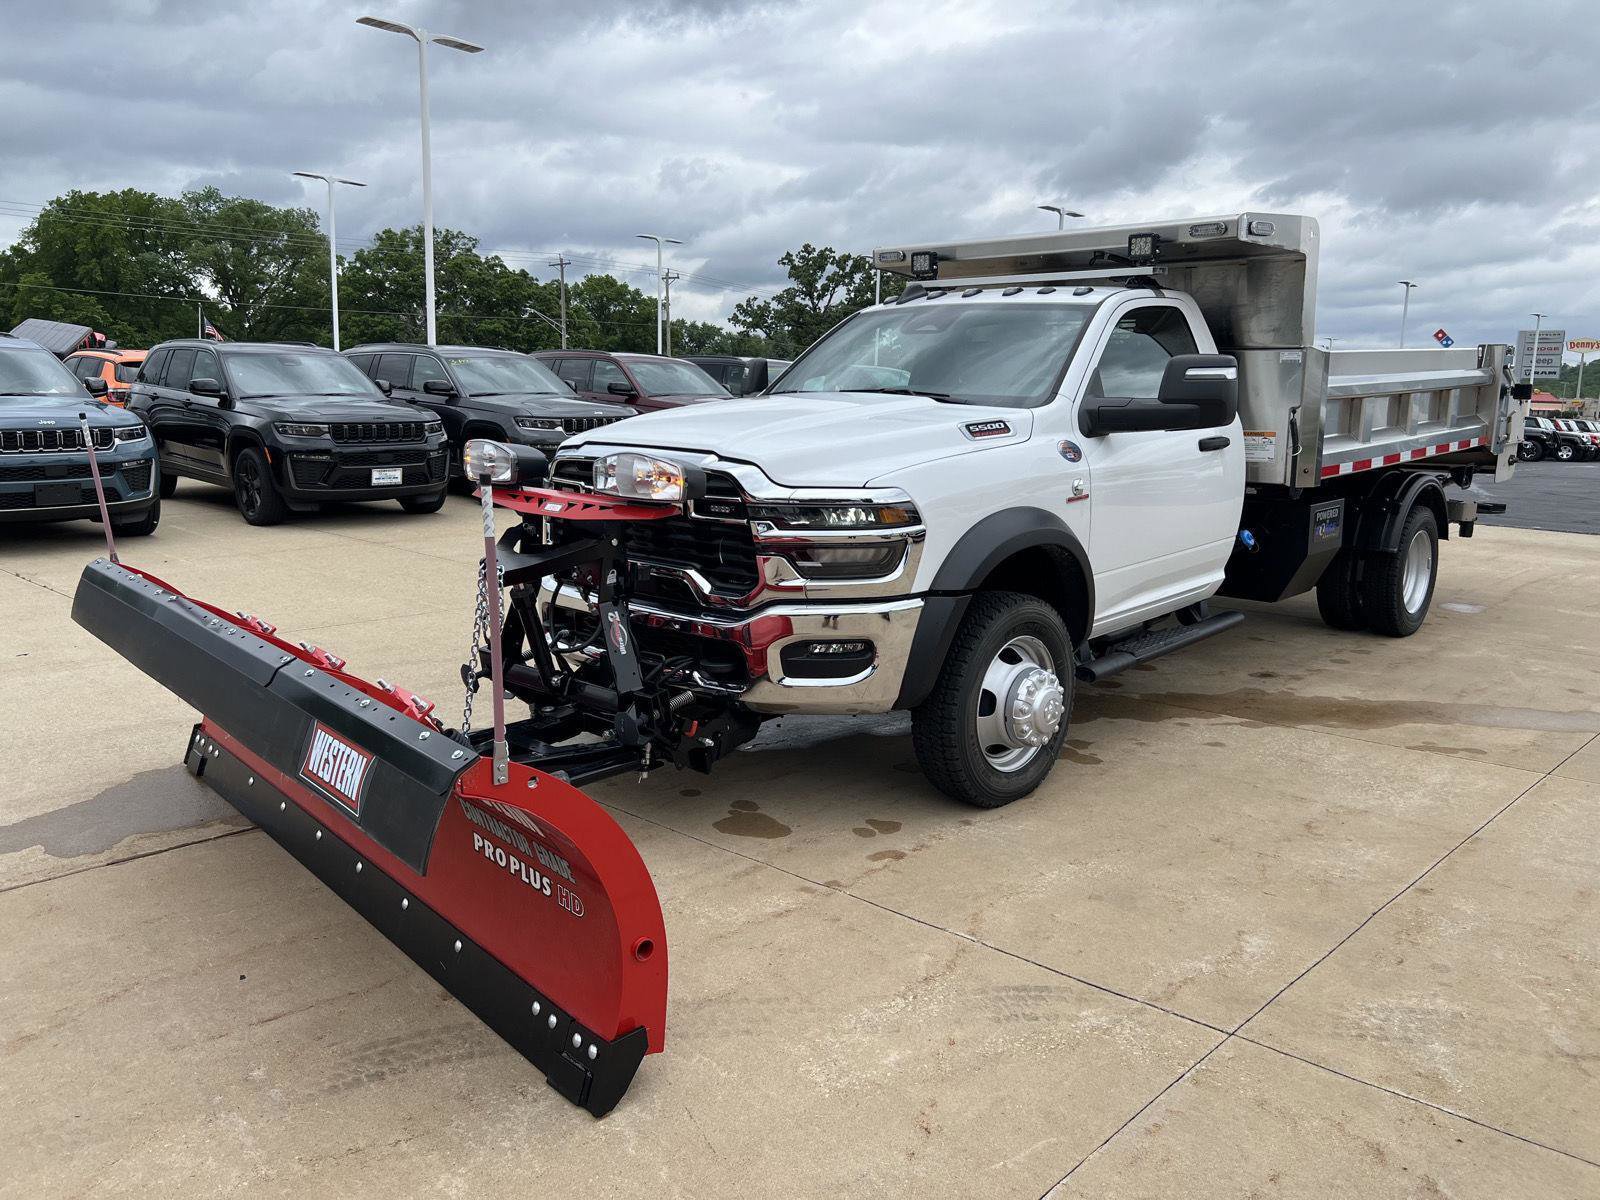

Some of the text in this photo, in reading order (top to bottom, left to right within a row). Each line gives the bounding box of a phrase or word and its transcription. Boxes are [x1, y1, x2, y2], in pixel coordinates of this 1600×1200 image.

[1569, 340, 1600, 349] Denny's
[969, 422, 1005, 432] 5500
[308, 729, 368, 801] WESTERN
[473, 831, 585, 917] PRO PLUS HD
[532, 841, 576, 884] GRADE
